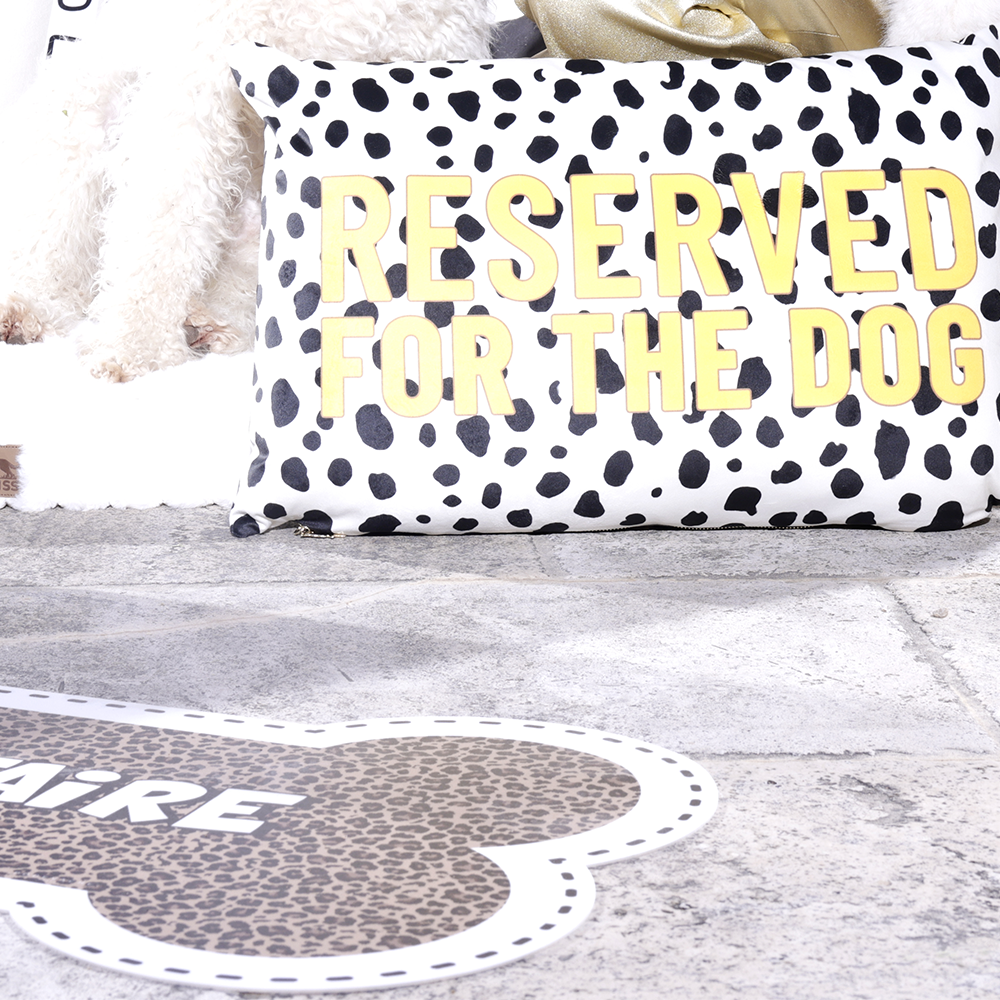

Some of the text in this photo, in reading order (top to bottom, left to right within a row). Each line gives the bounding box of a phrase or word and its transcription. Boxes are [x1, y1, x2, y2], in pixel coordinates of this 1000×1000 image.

[319, 167, 980, 304] RESERVED
[319, 302, 987, 420] FOR THE DOG
